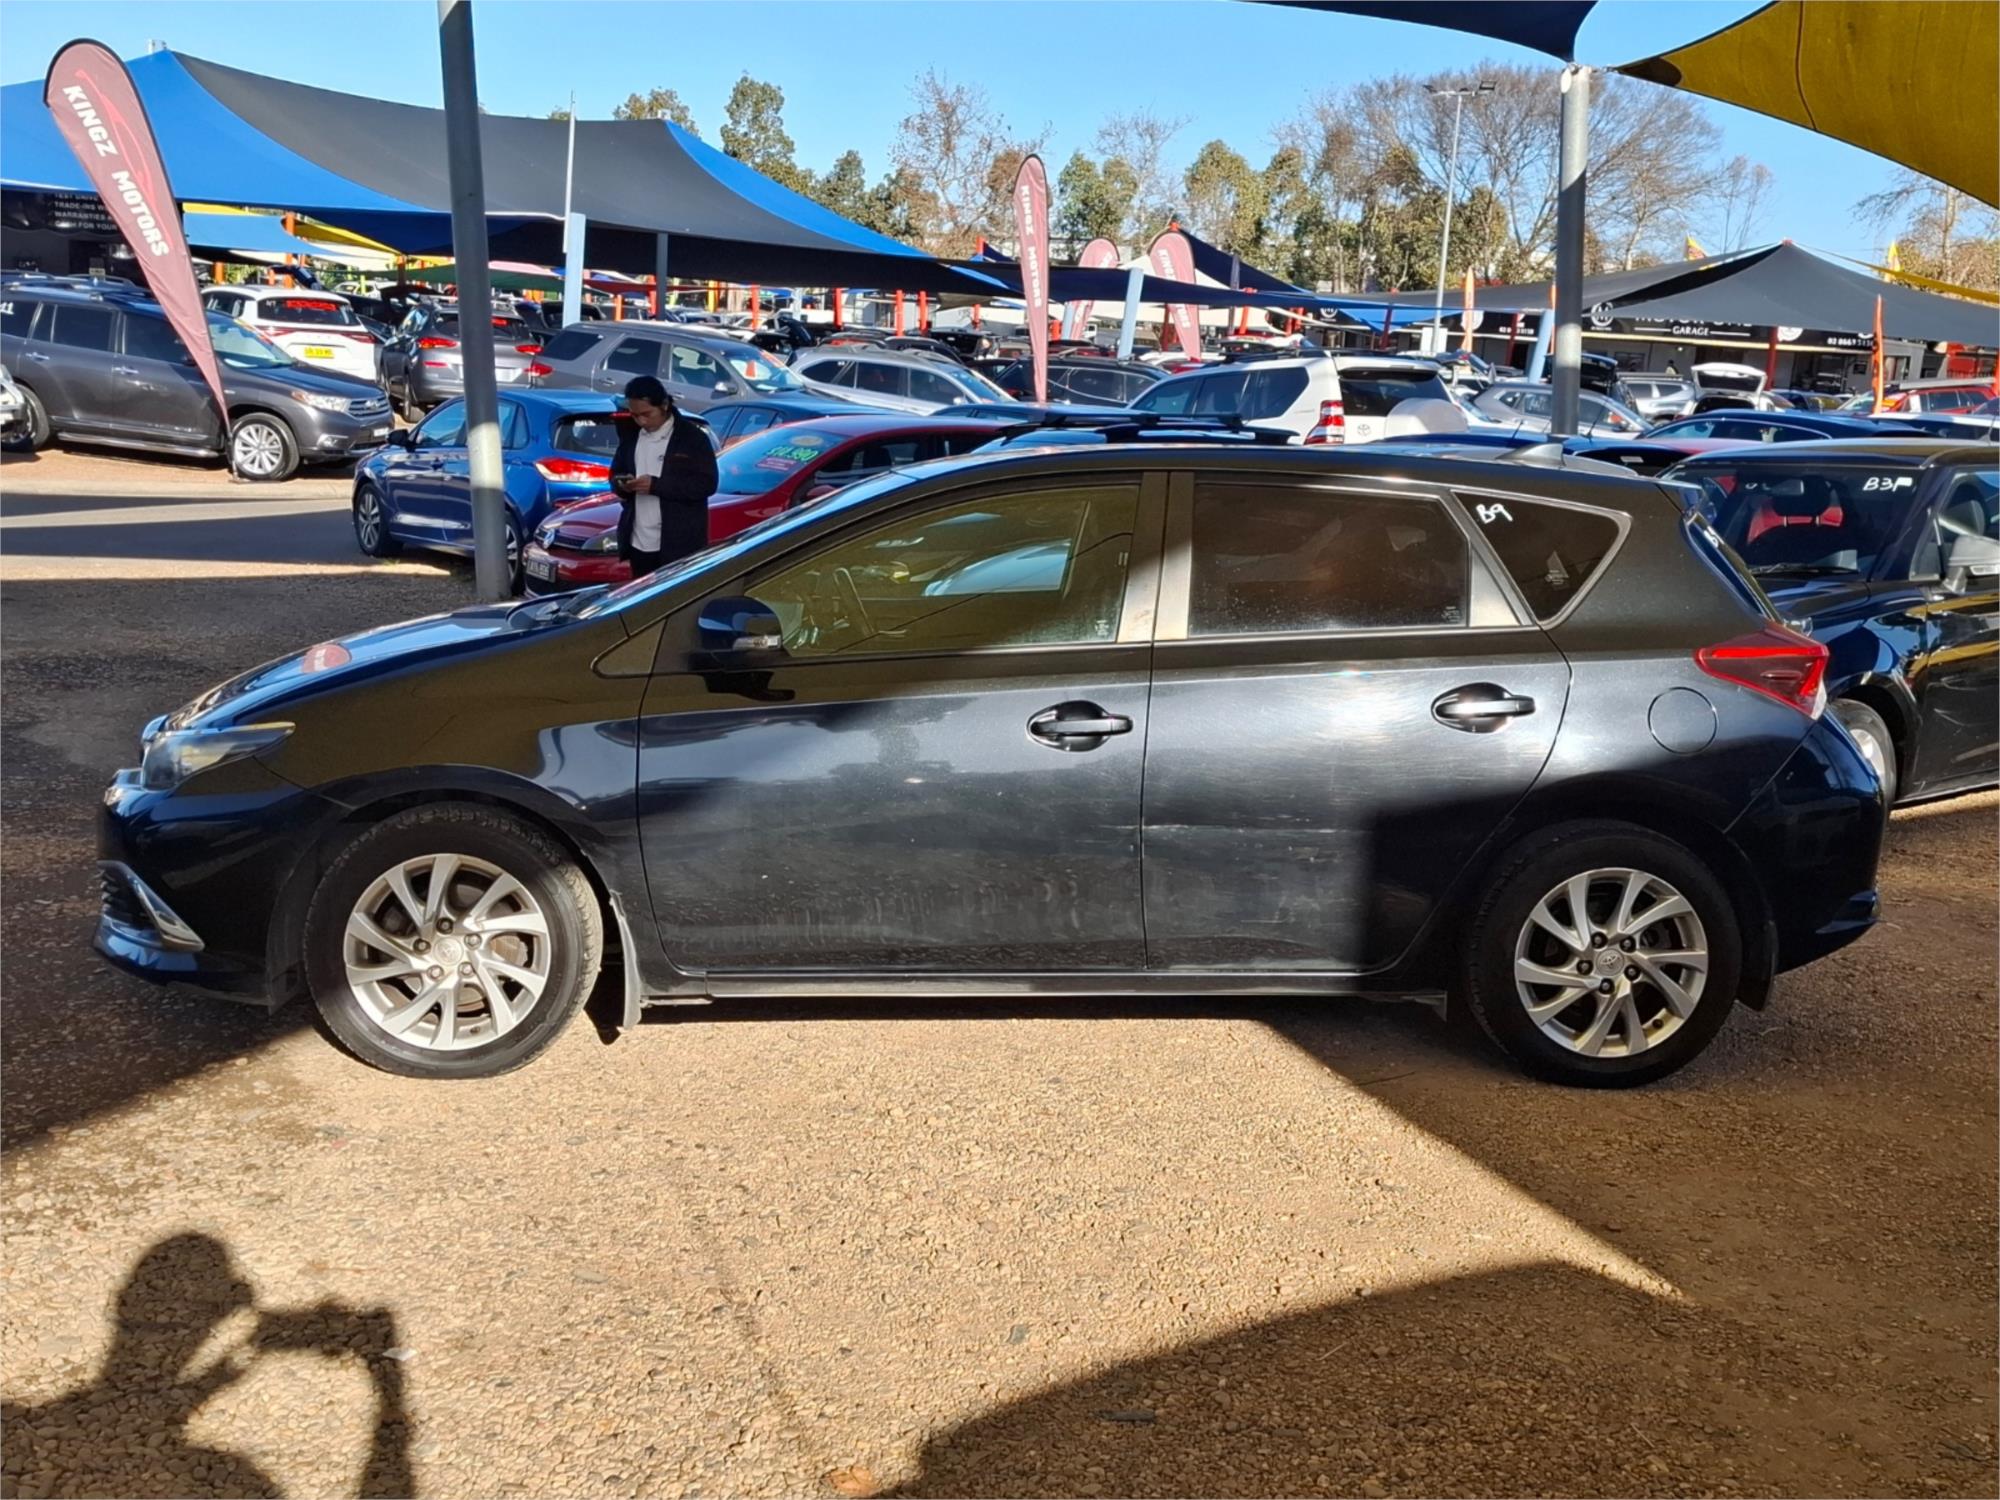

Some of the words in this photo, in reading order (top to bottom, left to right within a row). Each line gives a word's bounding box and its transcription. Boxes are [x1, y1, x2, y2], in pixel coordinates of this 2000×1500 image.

[62, 85, 119, 157] KINGZ
[111, 170, 170, 257] MOTORS
[1672, 325, 1709, 336] GARAGE
[1476, 503, 1513, 524] B9
